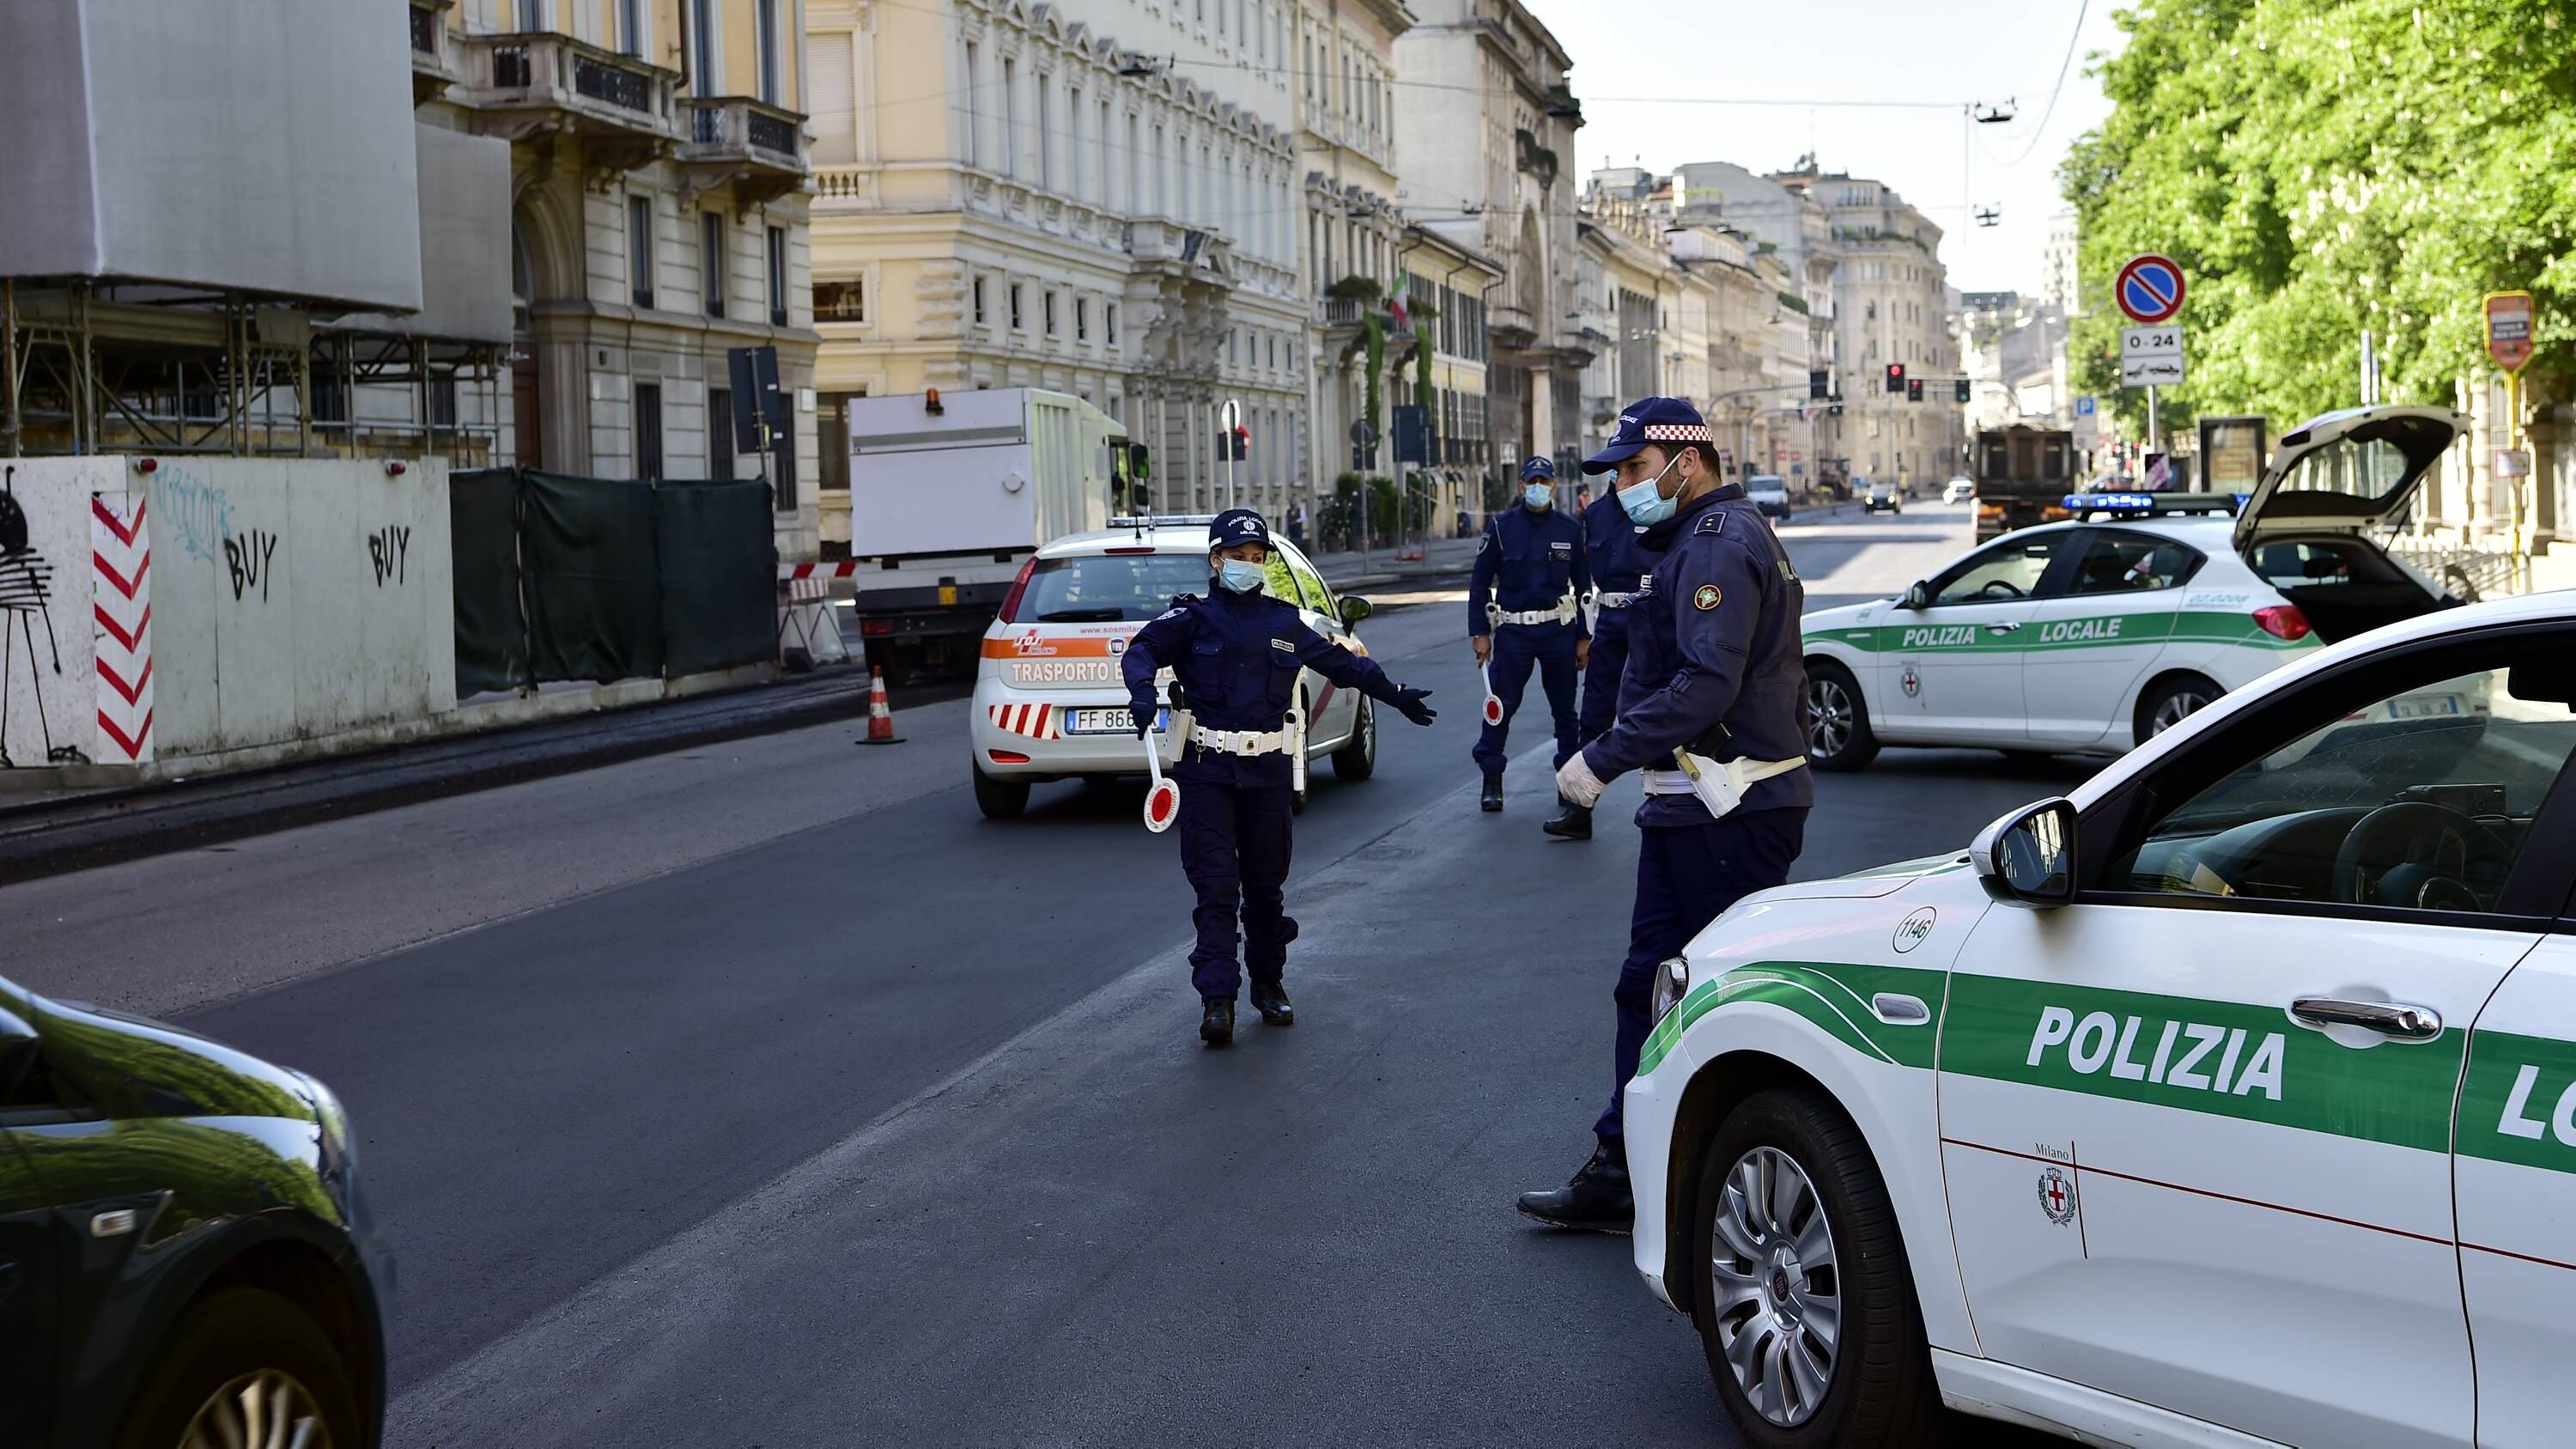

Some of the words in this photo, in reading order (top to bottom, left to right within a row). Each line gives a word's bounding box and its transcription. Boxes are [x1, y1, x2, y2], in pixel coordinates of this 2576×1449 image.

[2129, 336, 2141, 349] 0
[2153, 334, 2173, 347] 24
[223, 528, 277, 604] BUY
[368, 525, 410, 588] BUY
[1902, 626, 1976, 648] POLIZIA
[2039, 618, 2123, 642] LOCALE
[1012, 662, 1109, 682] TRASPORTO
[1078, 711, 1098, 728] FF
[1899, 918, 1932, 939] 1146
[2026, 1006, 2285, 1101] POLIZIA
[2035, 1142, 2069, 1160] Milano
